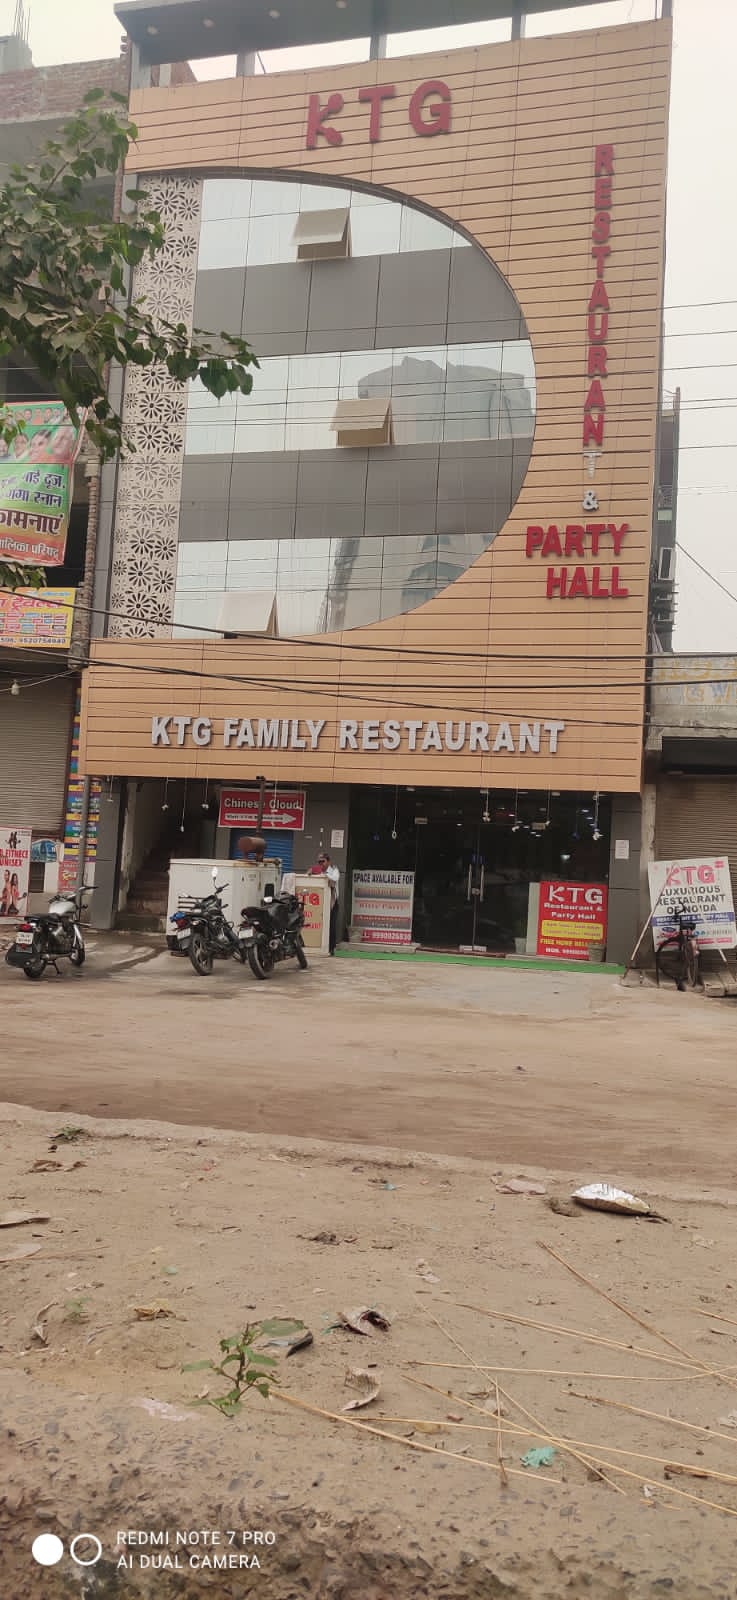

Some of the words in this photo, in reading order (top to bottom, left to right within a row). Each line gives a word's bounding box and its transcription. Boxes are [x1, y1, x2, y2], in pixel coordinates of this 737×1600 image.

[306, 80, 452, 150] KTG
[583, 144, 614, 479] RESTAURANT
[582, 490, 599, 512] &
[525, 523, 629, 558] PARTY
[546, 566, 629, 599] HALL
[151, 715, 213, 747] KTG
[223, 717, 326, 750] FAMILY
[339, 719, 566, 754] RESTAURANT
[353, 873, 370, 883] SPACE
[372, 873, 401, 884] AVAILABLE
[402, 874, 413, 885] FOR
[665, 864, 715, 887] KTG
[548, 884, 603, 905] KTG
[543, 902, 593, 911] Restaurant
[551, 911, 576, 920] Party
